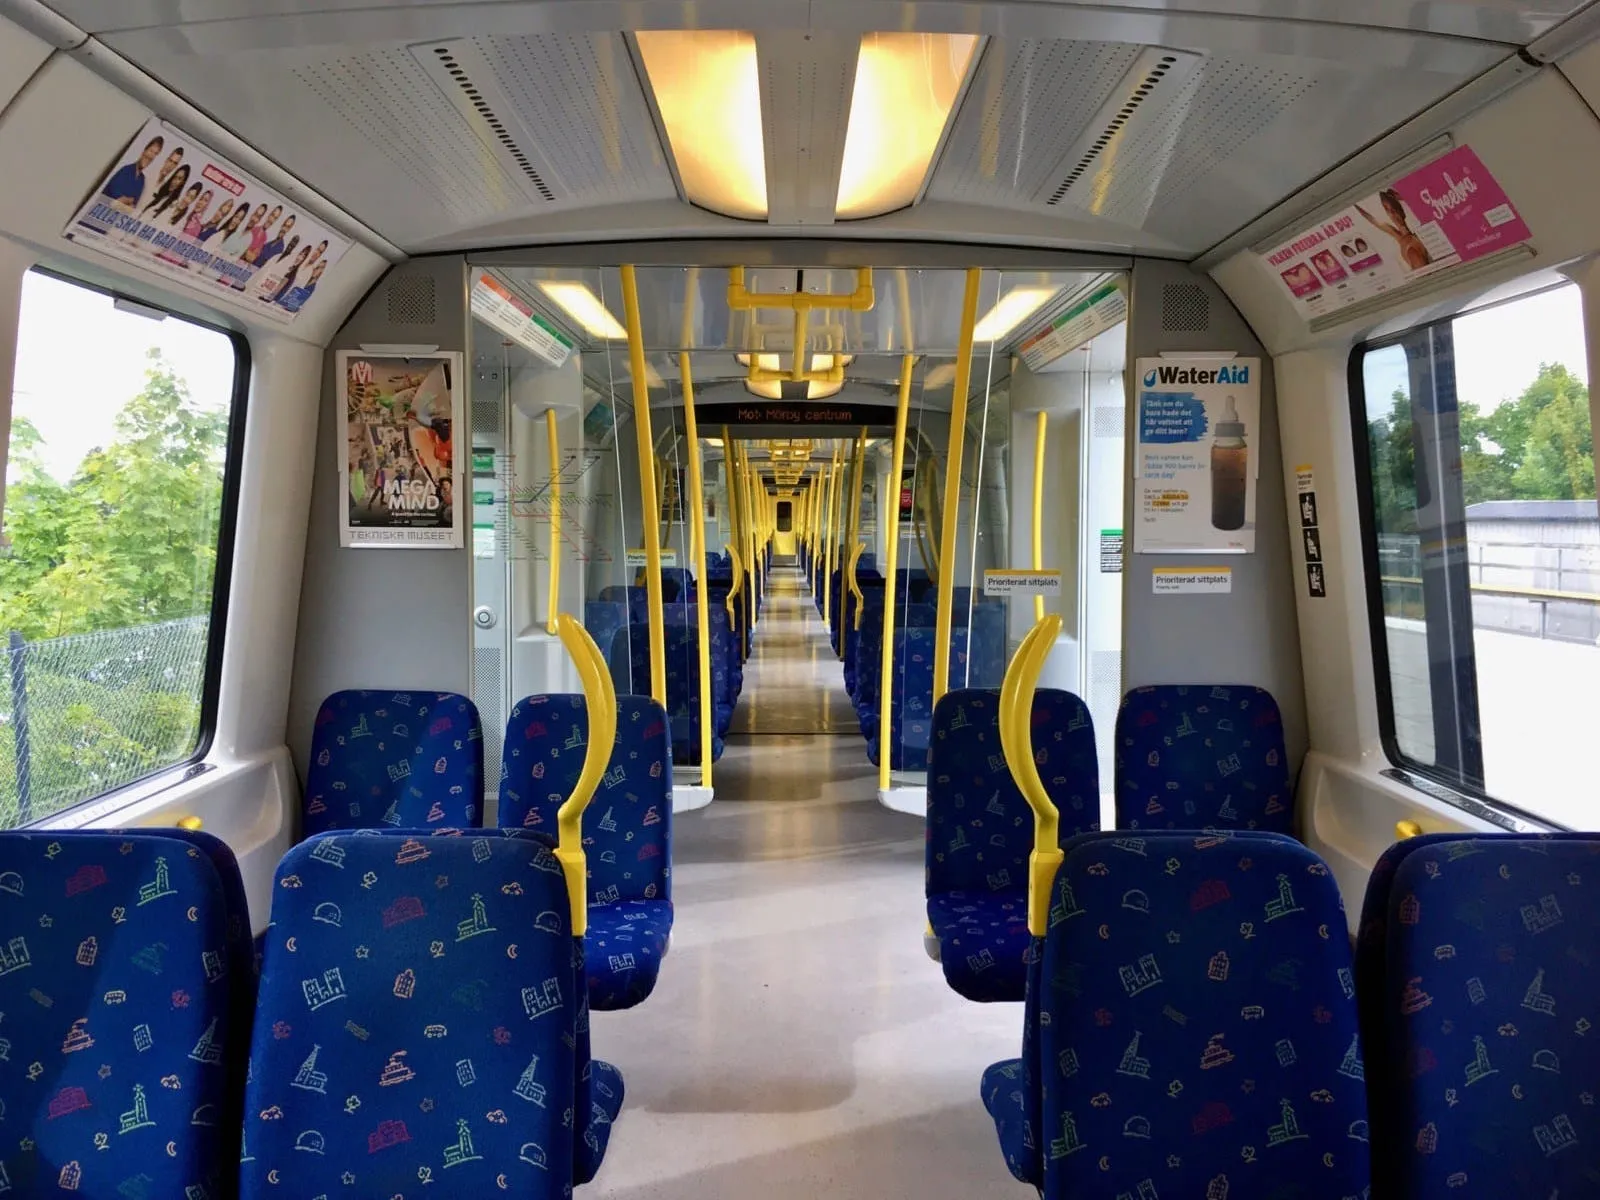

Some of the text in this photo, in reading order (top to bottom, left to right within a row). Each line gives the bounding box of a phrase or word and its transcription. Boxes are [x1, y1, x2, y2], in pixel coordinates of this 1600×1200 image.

[89, 203, 117, 226] ALLA
[116, 213, 139, 235] SKA
[138, 224, 157, 242] HA
[1159, 366, 1248, 384] WaterAid
[805, 409, 852, 421] centrum
[384, 478, 436, 494] MEGA
[389, 494, 440, 510] MIND
[350, 531, 453, 540] TEKNISKA MUSEET
[988, 578, 1058, 586] Prioriterad sittplats
[1156, 576, 1227, 584] Prioriterad sittplats
